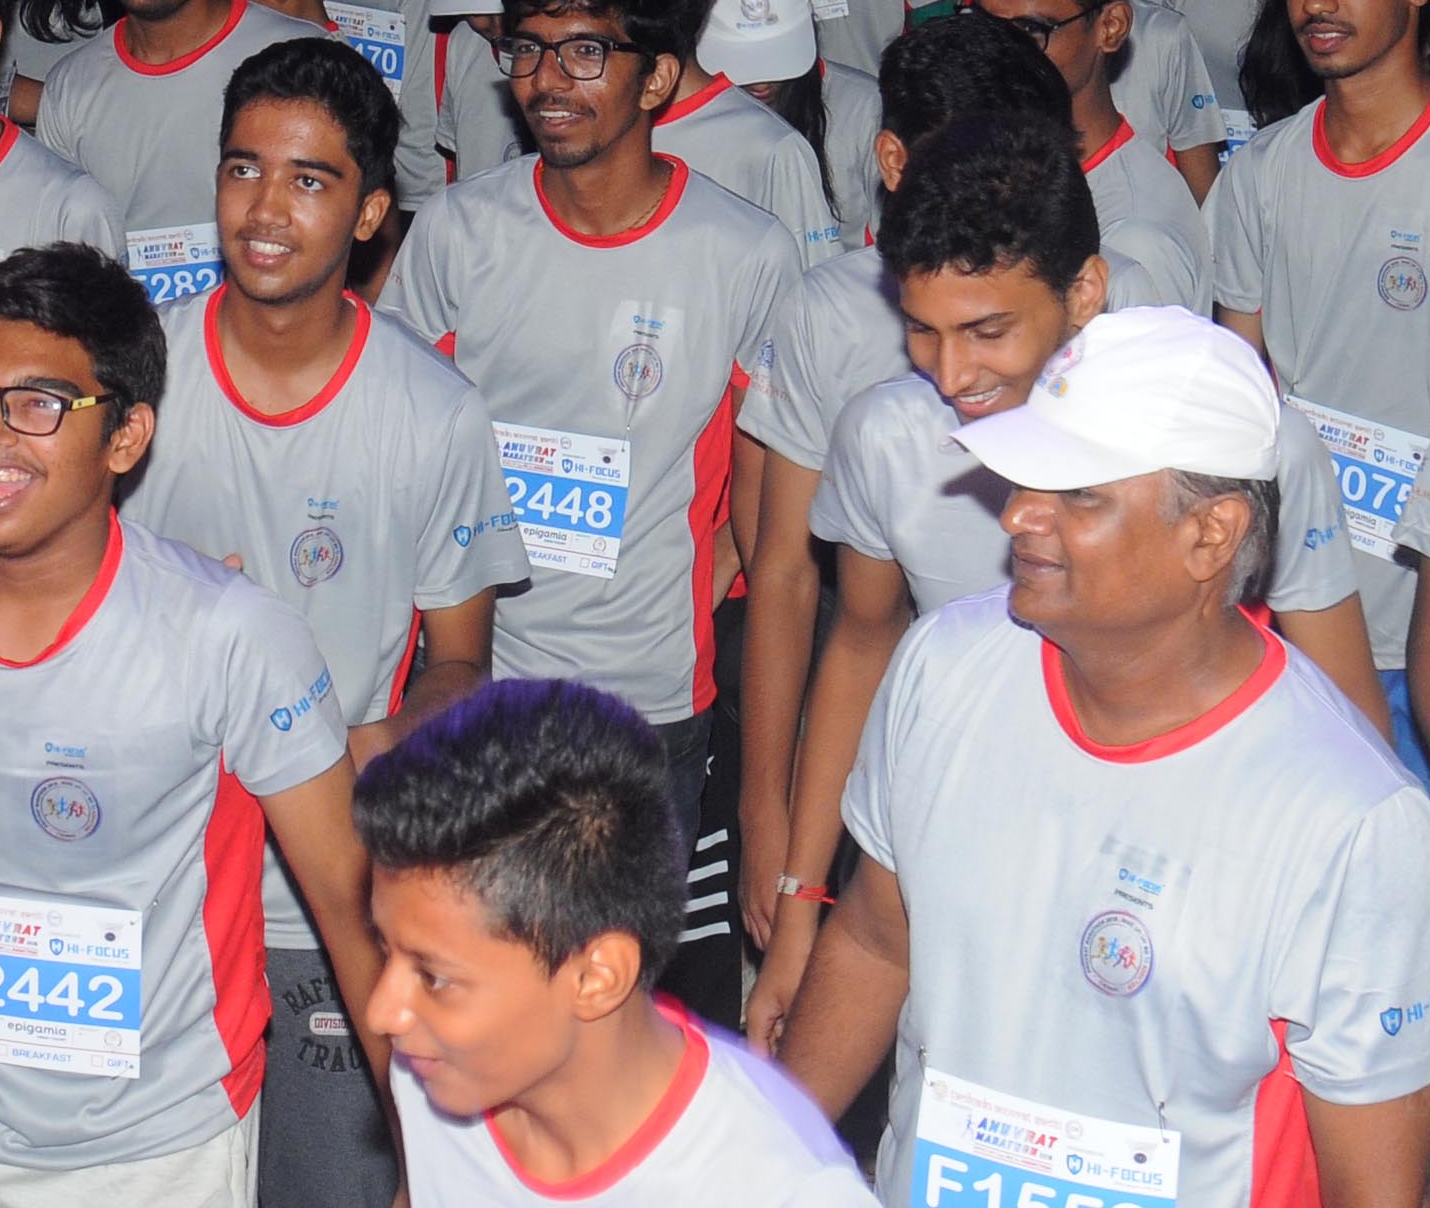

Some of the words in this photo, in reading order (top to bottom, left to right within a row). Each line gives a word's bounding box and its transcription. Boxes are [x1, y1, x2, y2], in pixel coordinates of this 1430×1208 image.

[502, 440, 557, 457] ANUVRAT
[574, 462, 621, 479] HI-FOCUS
[505, 475, 613, 529] 2448
[523, 527, 567, 542] epigamia
[527, 550, 568, 564] REAKFAST
[66, 942, 130, 960] HI-FOCUS
[7, 1020, 67, 1039] epigamia
[11, 1047, 73, 1064] BREAKFAST
[976, 1116, 1058, 1150] ANUVRAT
[1087, 1160, 1164, 1186] HI-FOCUS
